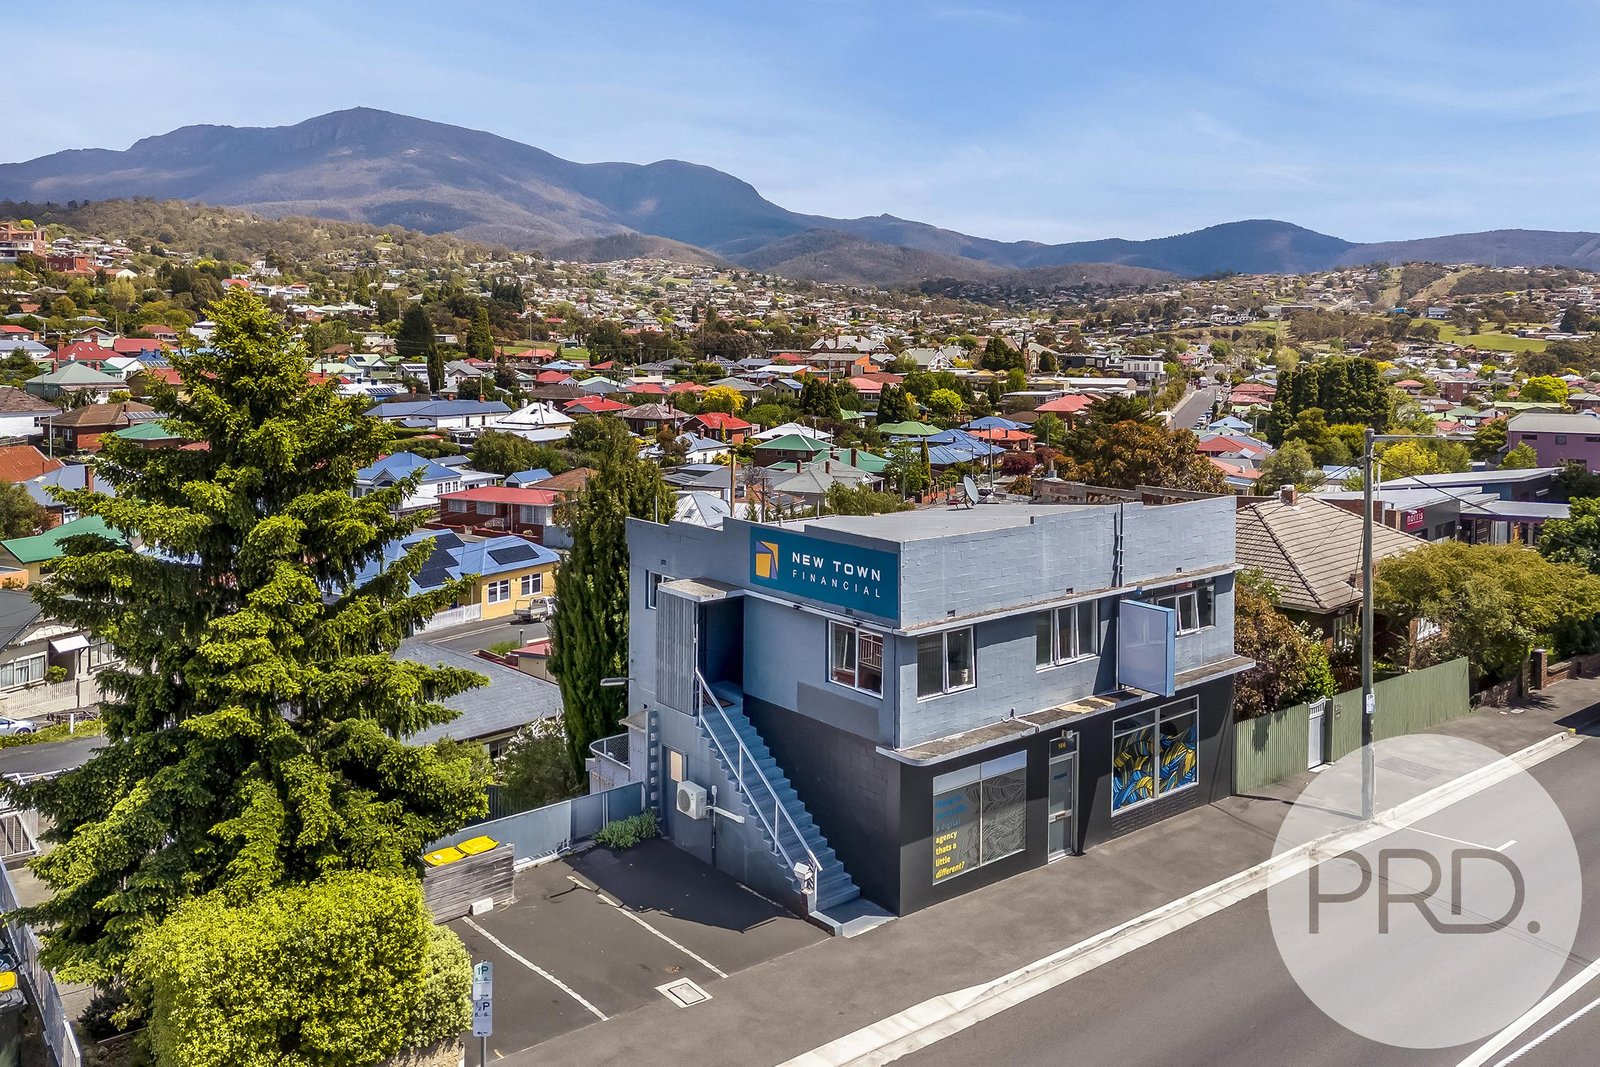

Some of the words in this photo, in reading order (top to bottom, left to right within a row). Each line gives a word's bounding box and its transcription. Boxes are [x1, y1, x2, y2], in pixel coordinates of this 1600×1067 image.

[1407, 510, 1423, 522] norris
[792, 552, 824, 568] NEW
[833, 560, 881, 582] TOWN
[792, 570, 881, 598] FINANCIAL
[936, 831, 958, 845] agency
[936, 845, 951, 856] thats
[936, 856, 950, 867] little
[936, 862, 965, 880] different?
[478, 965, 489, 975] 1P
